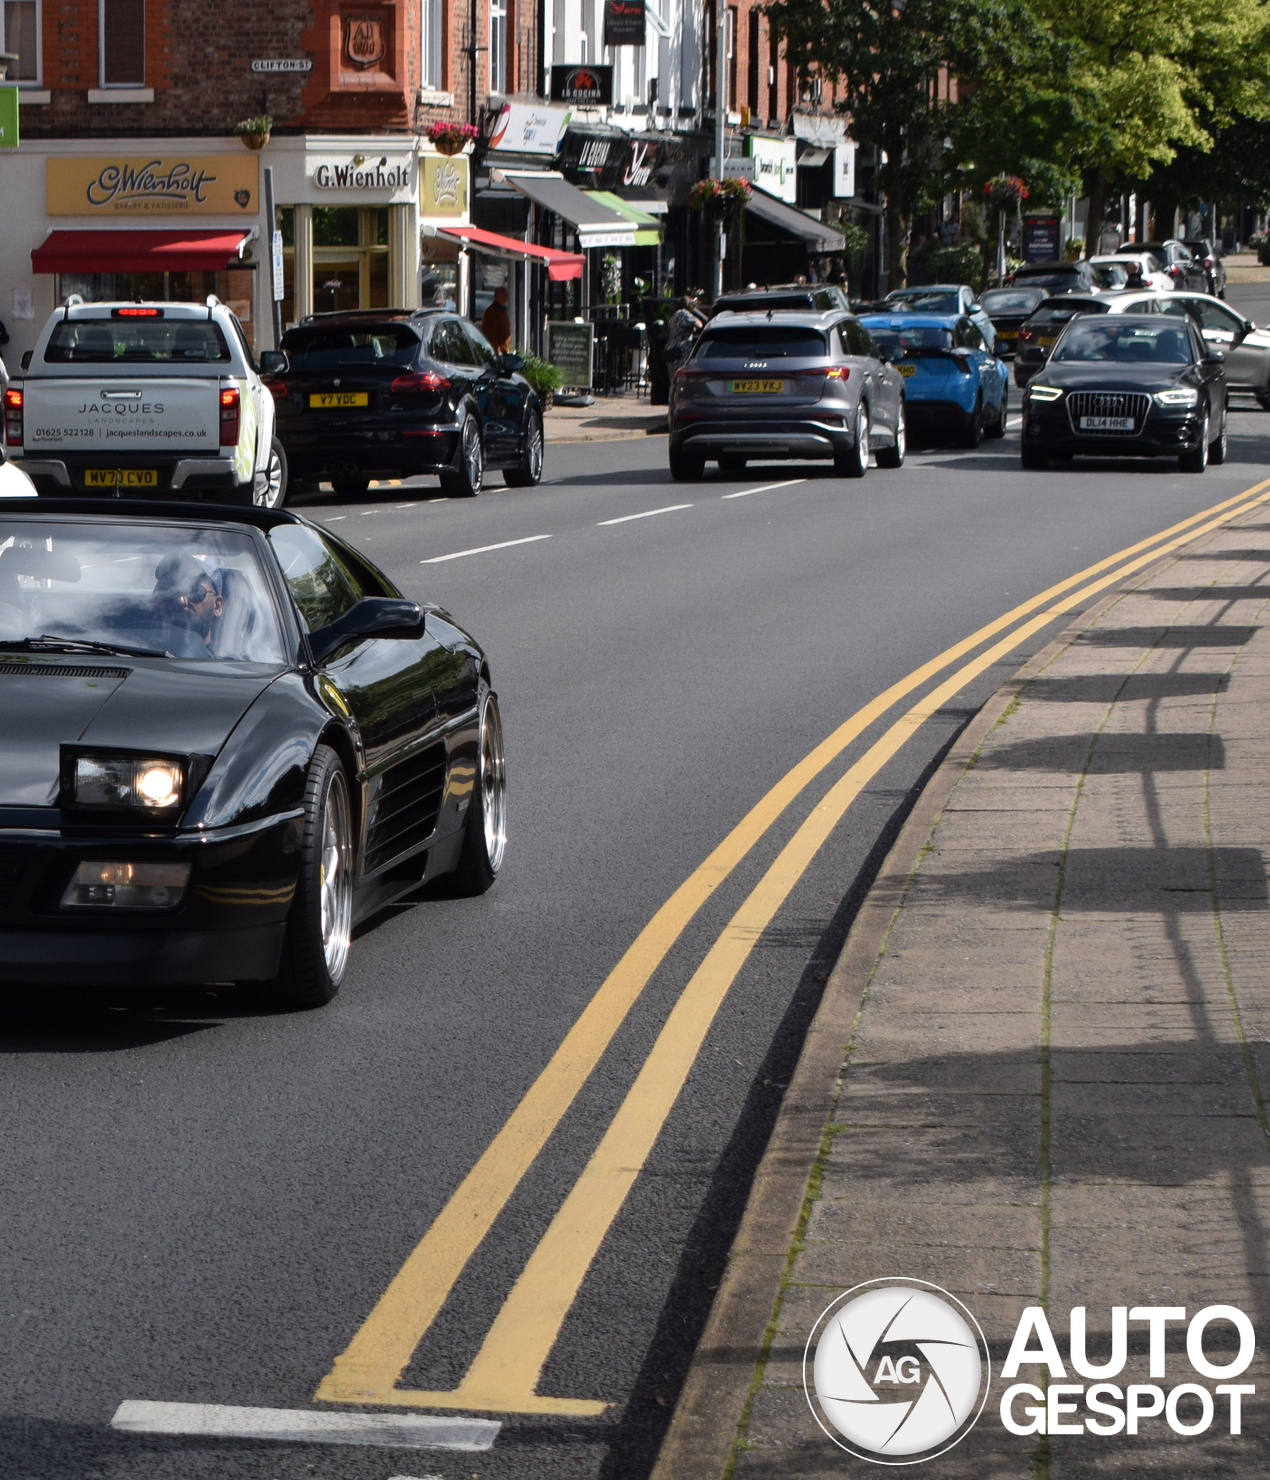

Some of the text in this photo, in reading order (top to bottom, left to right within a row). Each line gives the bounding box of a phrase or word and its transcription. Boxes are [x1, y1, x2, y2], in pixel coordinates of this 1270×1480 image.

[254, 60, 295, 70] CLIFTON
[317, 164, 410, 188] G.Wienholt
[87, 160, 217, 206] G.Wienholt
[321, 394, 356, 405] V7 VDC
[78, 403, 165, 415] JACQUES
[35, 428, 61, 437] 01625
[63, 428, 94, 437] 522128
[106, 428, 207, 439] jacqueslandscapes.co.uk
[127, 471, 153, 484] CVO
